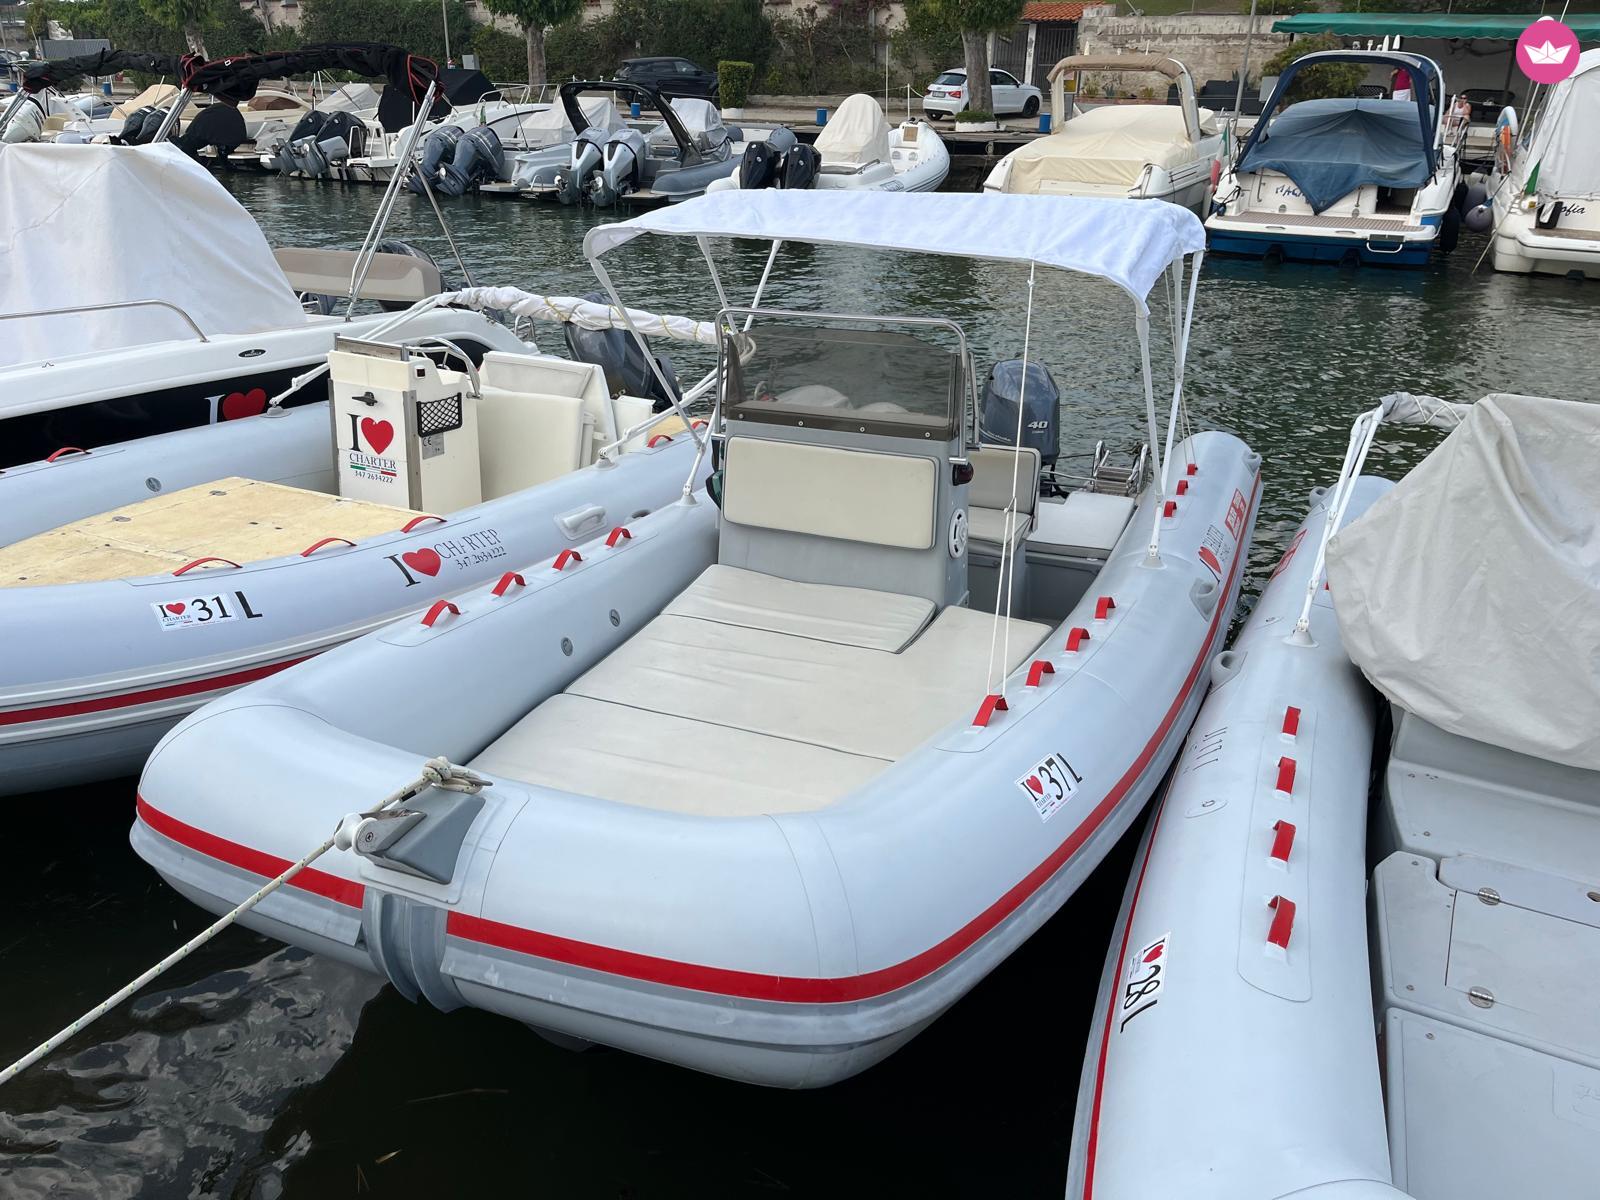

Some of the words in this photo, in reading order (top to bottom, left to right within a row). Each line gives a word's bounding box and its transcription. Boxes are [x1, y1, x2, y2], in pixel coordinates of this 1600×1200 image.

[1560, 203, 1586, 217] ofia
[204, 394, 226, 424] I
[346, 413, 363, 453] I
[1027, 421, 1049, 429] 40
[349, 452, 397, 470] CHARTER
[383, 553, 421, 587] I
[157, 604, 169, 619] I
[191, 595, 233, 622] 31
[234, 590, 264, 620] L
[1020, 781, 1038, 802] I
[1038, 757, 1072, 801] 37
[1056, 752, 1083, 784] L
[1123, 964, 1162, 1010] 28
